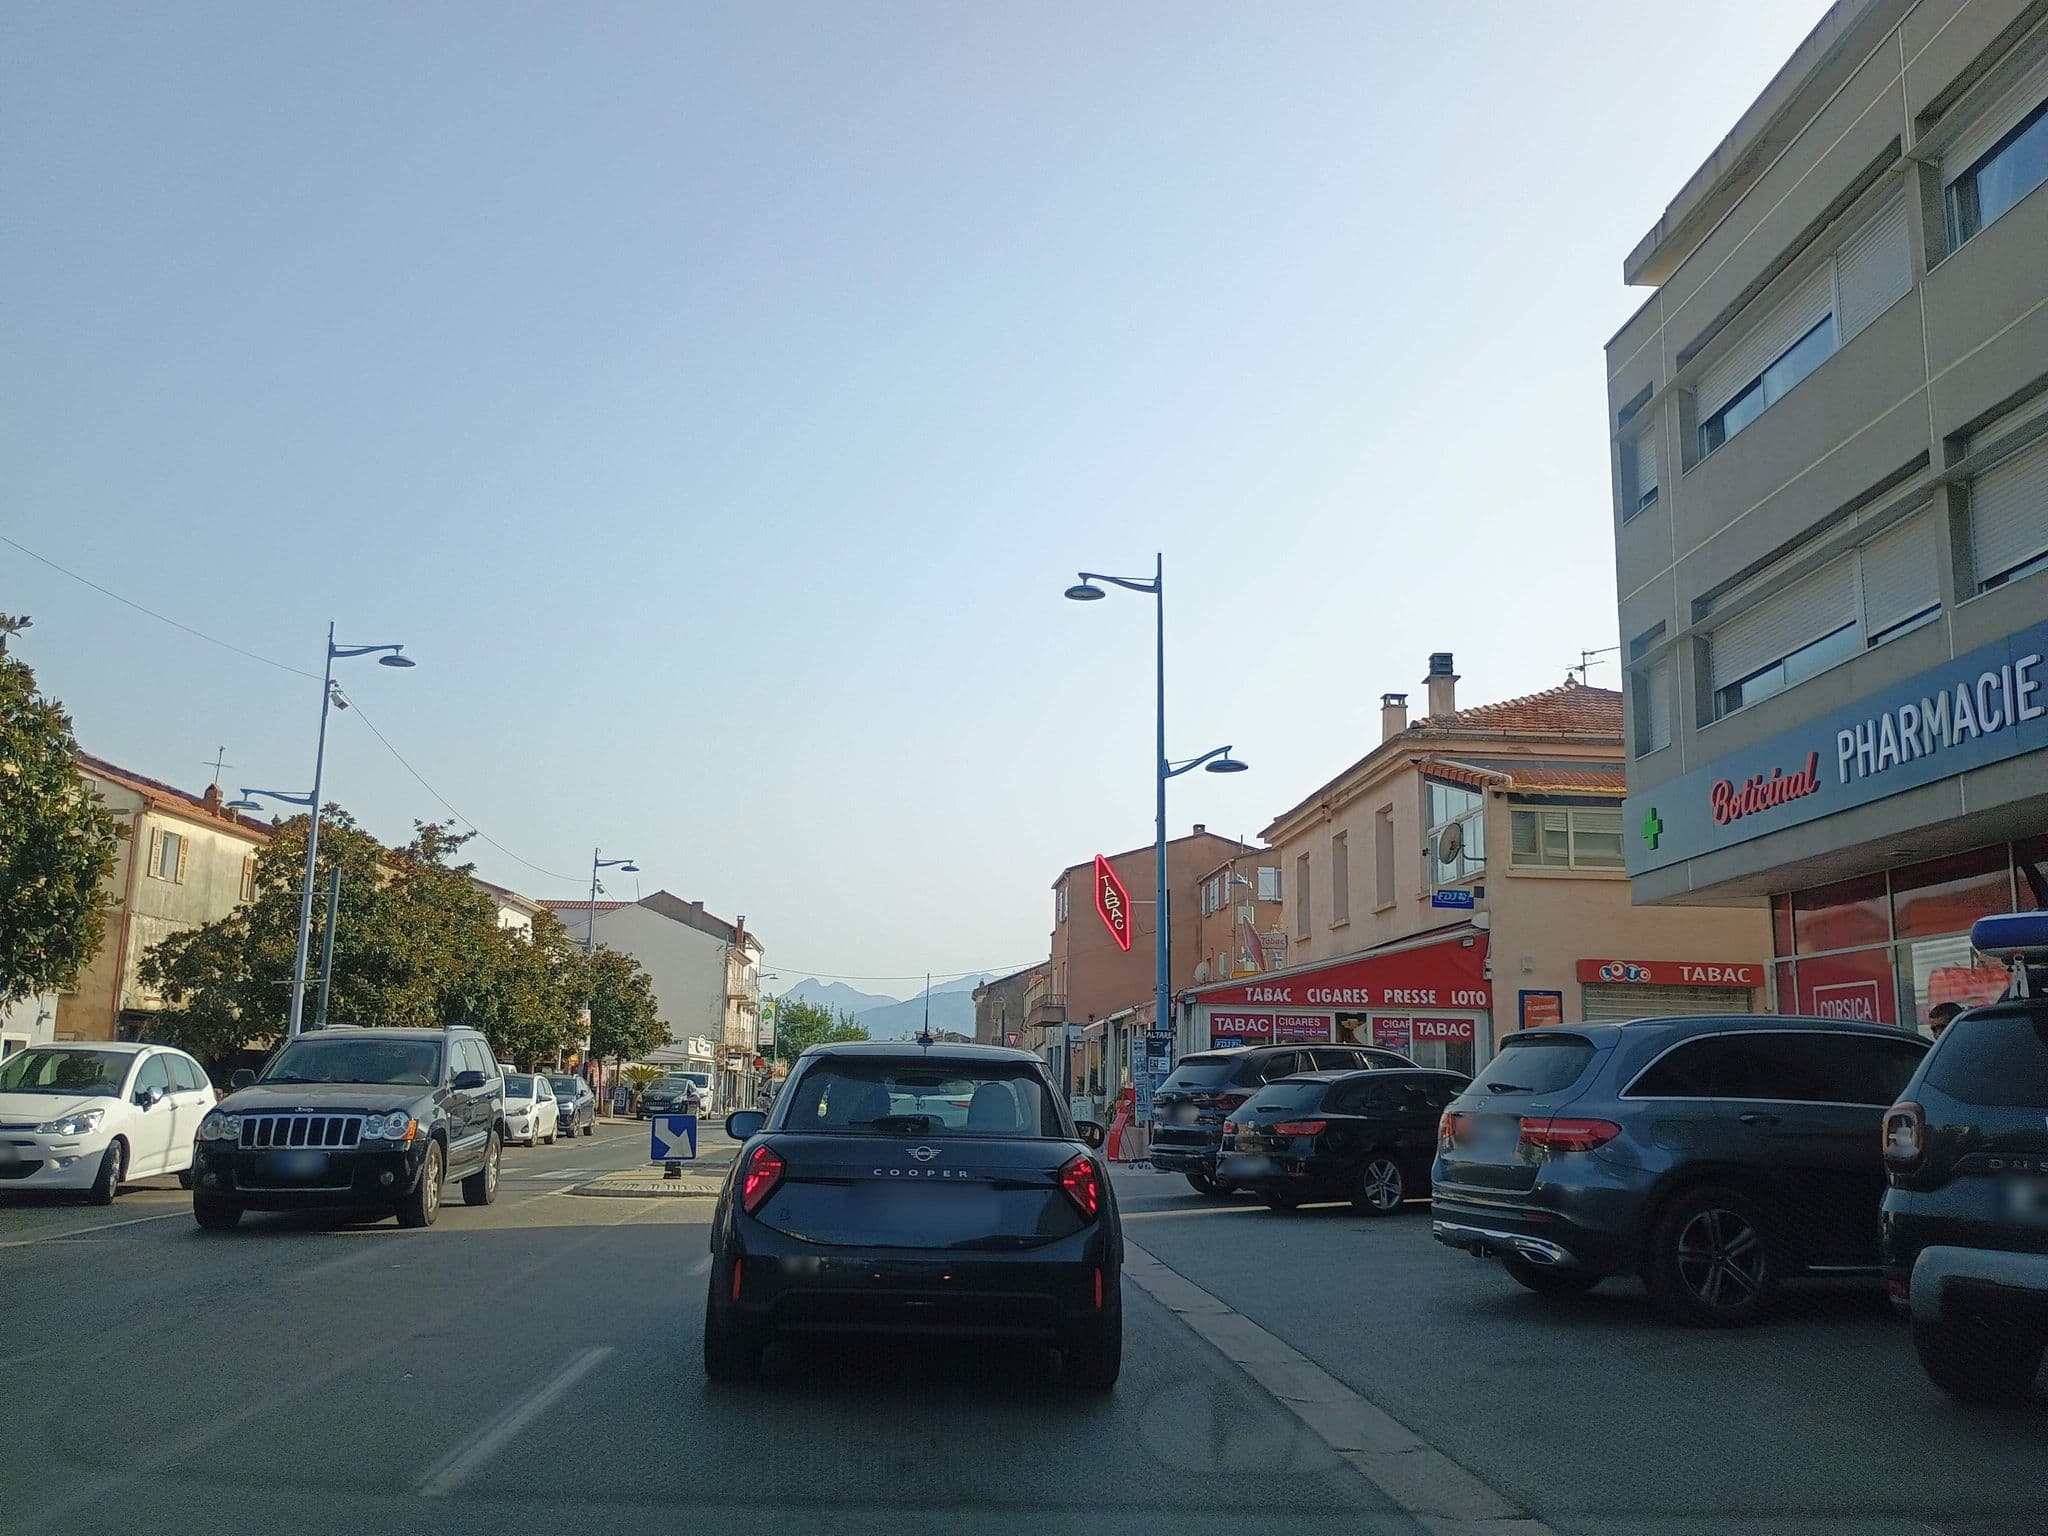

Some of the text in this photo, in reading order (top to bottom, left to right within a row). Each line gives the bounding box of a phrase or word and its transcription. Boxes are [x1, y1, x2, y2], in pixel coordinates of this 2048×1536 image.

[1709, 654, 2047, 826] Boticinal PHARMACIE
[1100, 875, 1124, 930] TABAC
[1680, 966, 1751, 983] TABAC
[1245, 987, 1487, 1006] TABAC CIGARES PRESSE LOTO
[1820, 997, 1873, 1020] CORSICA
[1215, 1017, 1270, 1032] TABAC
[1278, 1017, 1321, 1027] CIGARES
[1416, 1022, 1471, 1037] TABAC
[873, 1168, 968, 1178] COOPER
